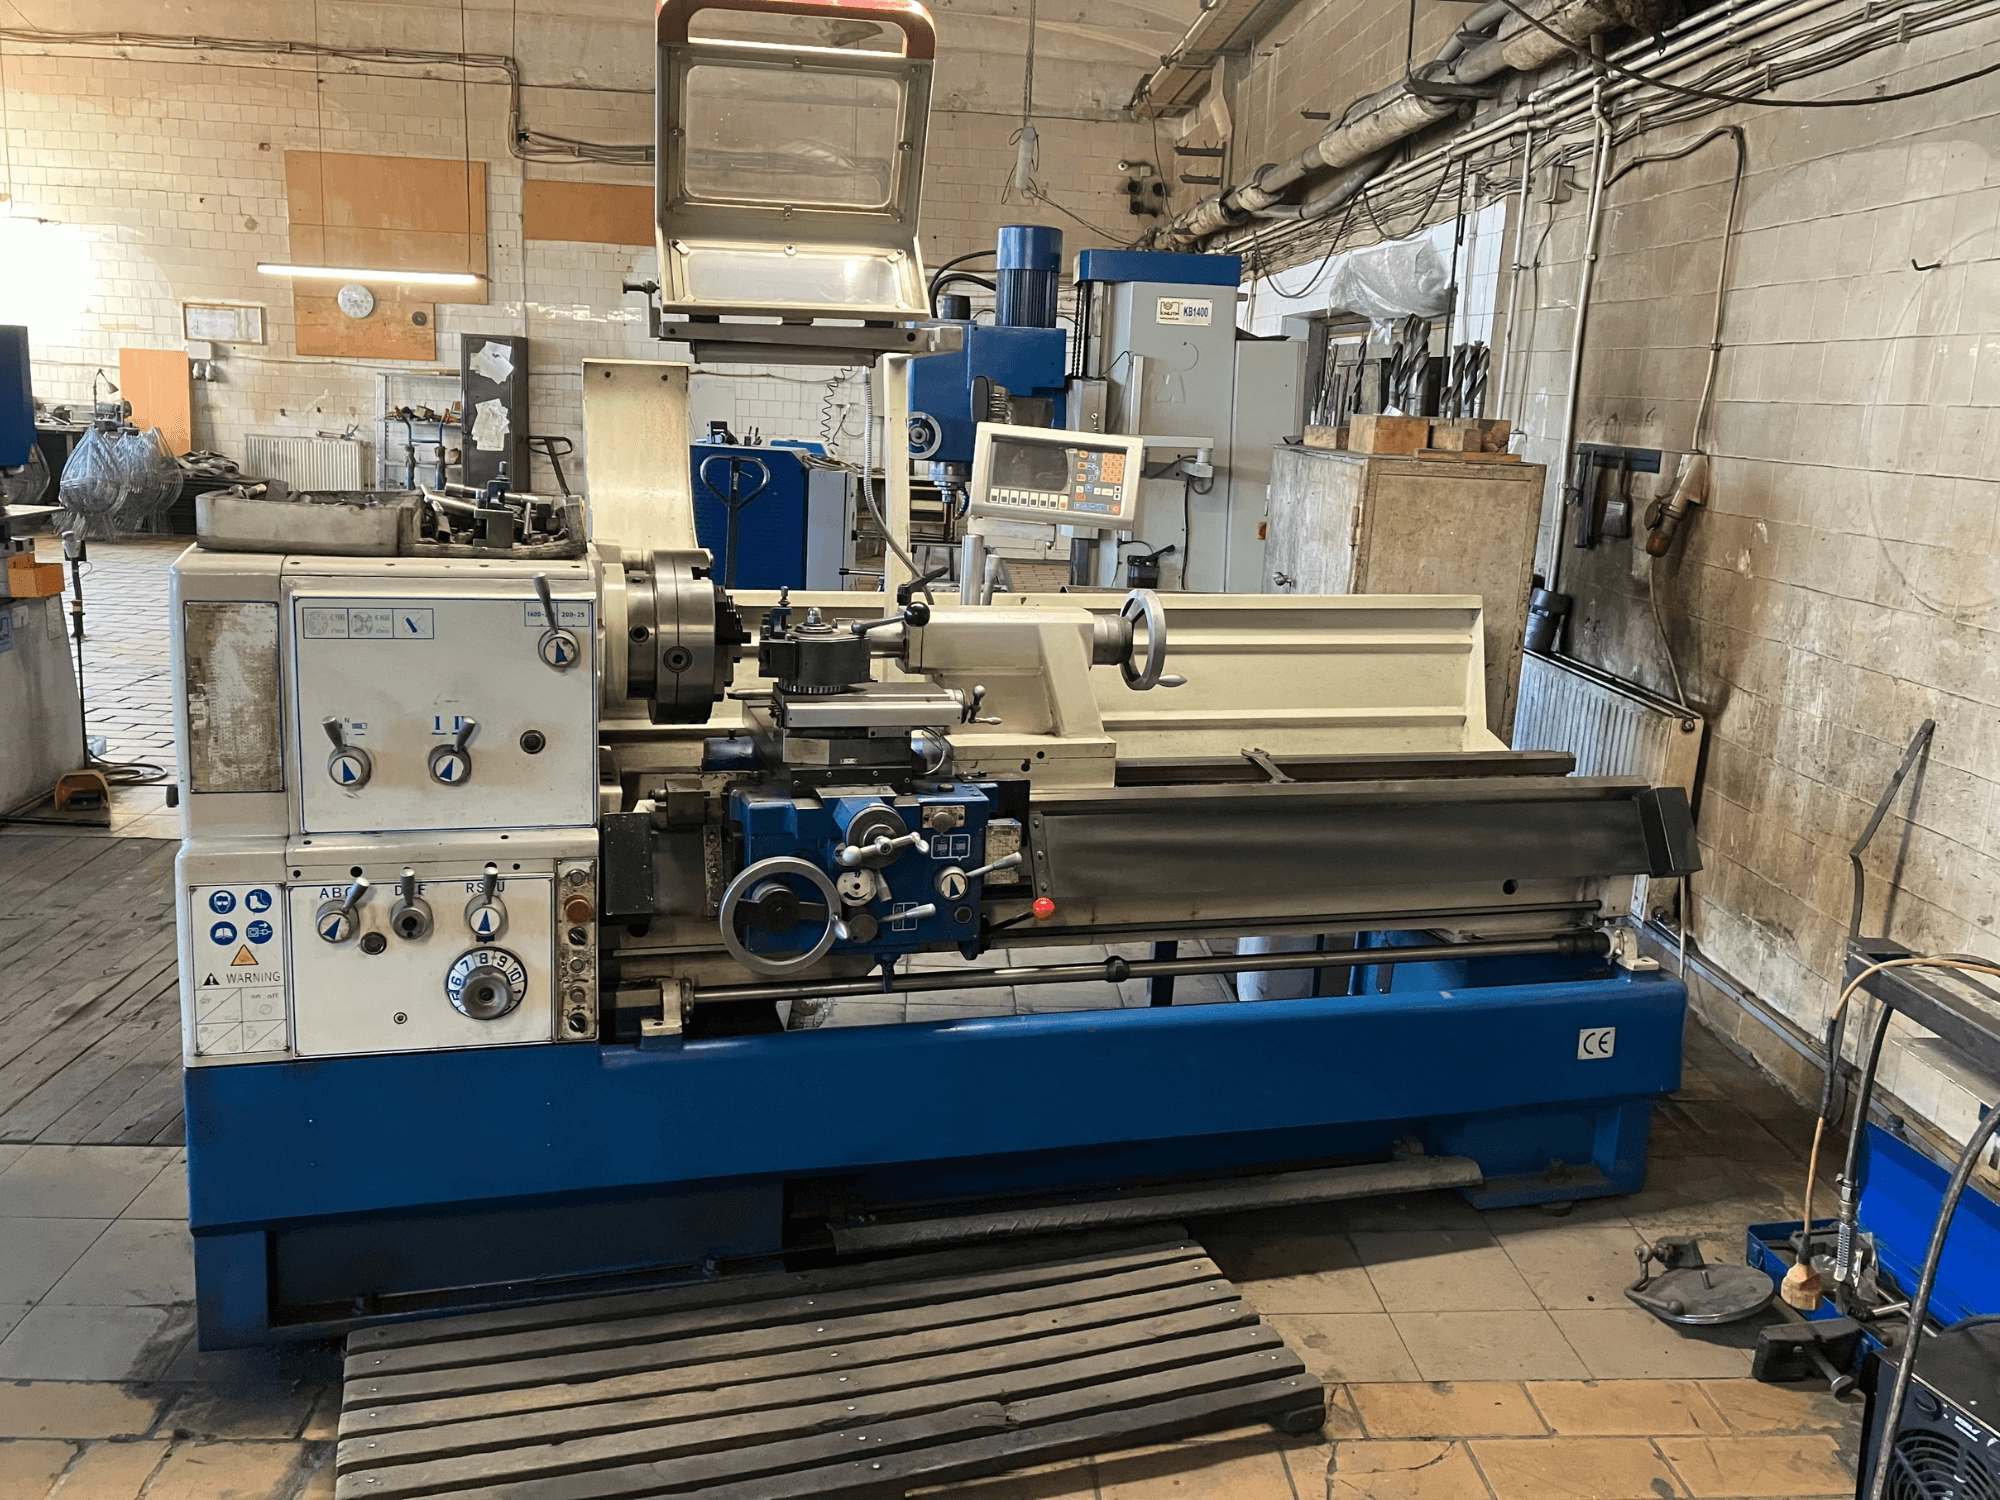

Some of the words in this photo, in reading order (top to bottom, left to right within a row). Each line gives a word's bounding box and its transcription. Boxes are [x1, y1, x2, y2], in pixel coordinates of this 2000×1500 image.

[1183, 306, 1209, 318] KB1400
[394, 884, 427, 896] DF
[466, 881, 505, 894] RSU
[460, 959, 470, 972] 7
[479, 953, 488, 964] 8
[496, 955, 508, 968] 9
[508, 967, 522, 983] 10
[226, 971, 281, 984] WARNING
[1583, 1031, 1611, 1055] CE
